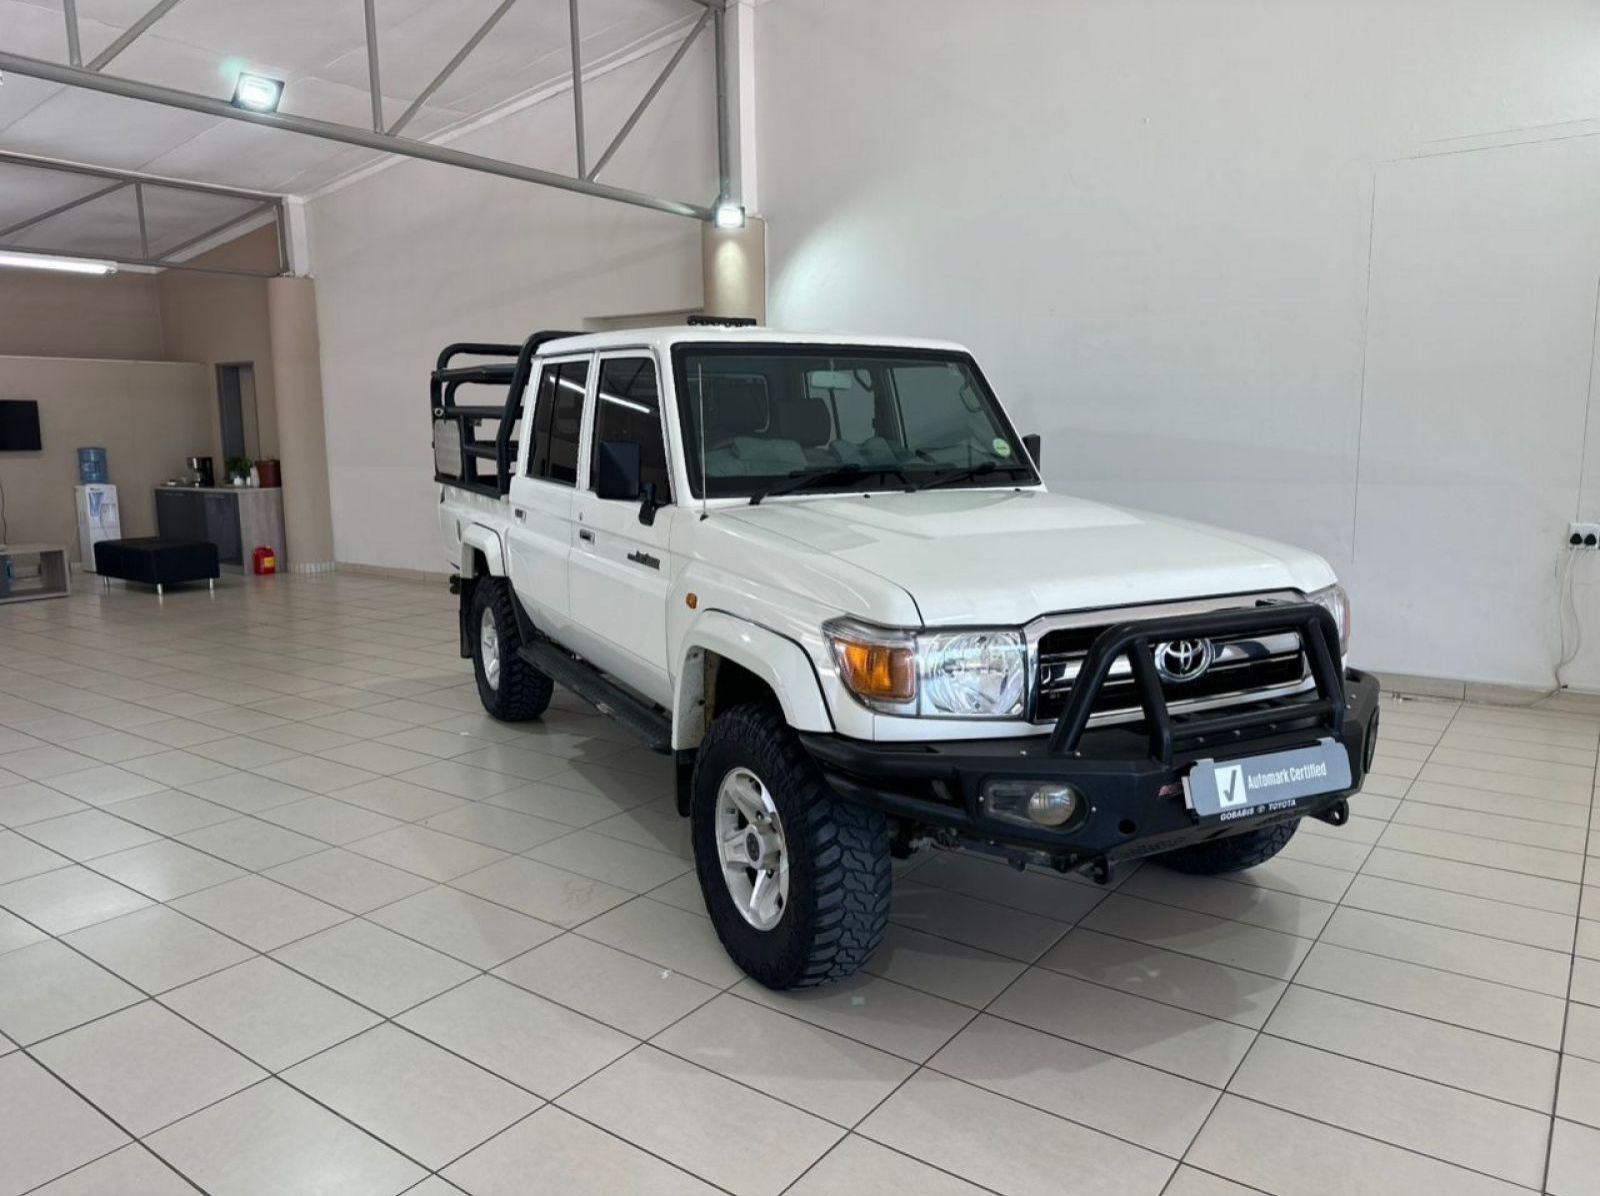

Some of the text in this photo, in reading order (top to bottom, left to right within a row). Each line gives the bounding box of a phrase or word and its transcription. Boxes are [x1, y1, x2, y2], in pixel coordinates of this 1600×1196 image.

[1248, 762, 1327, 790] Automark Certified
[1220, 799, 1296, 821] GOBABIS TOYOTA
